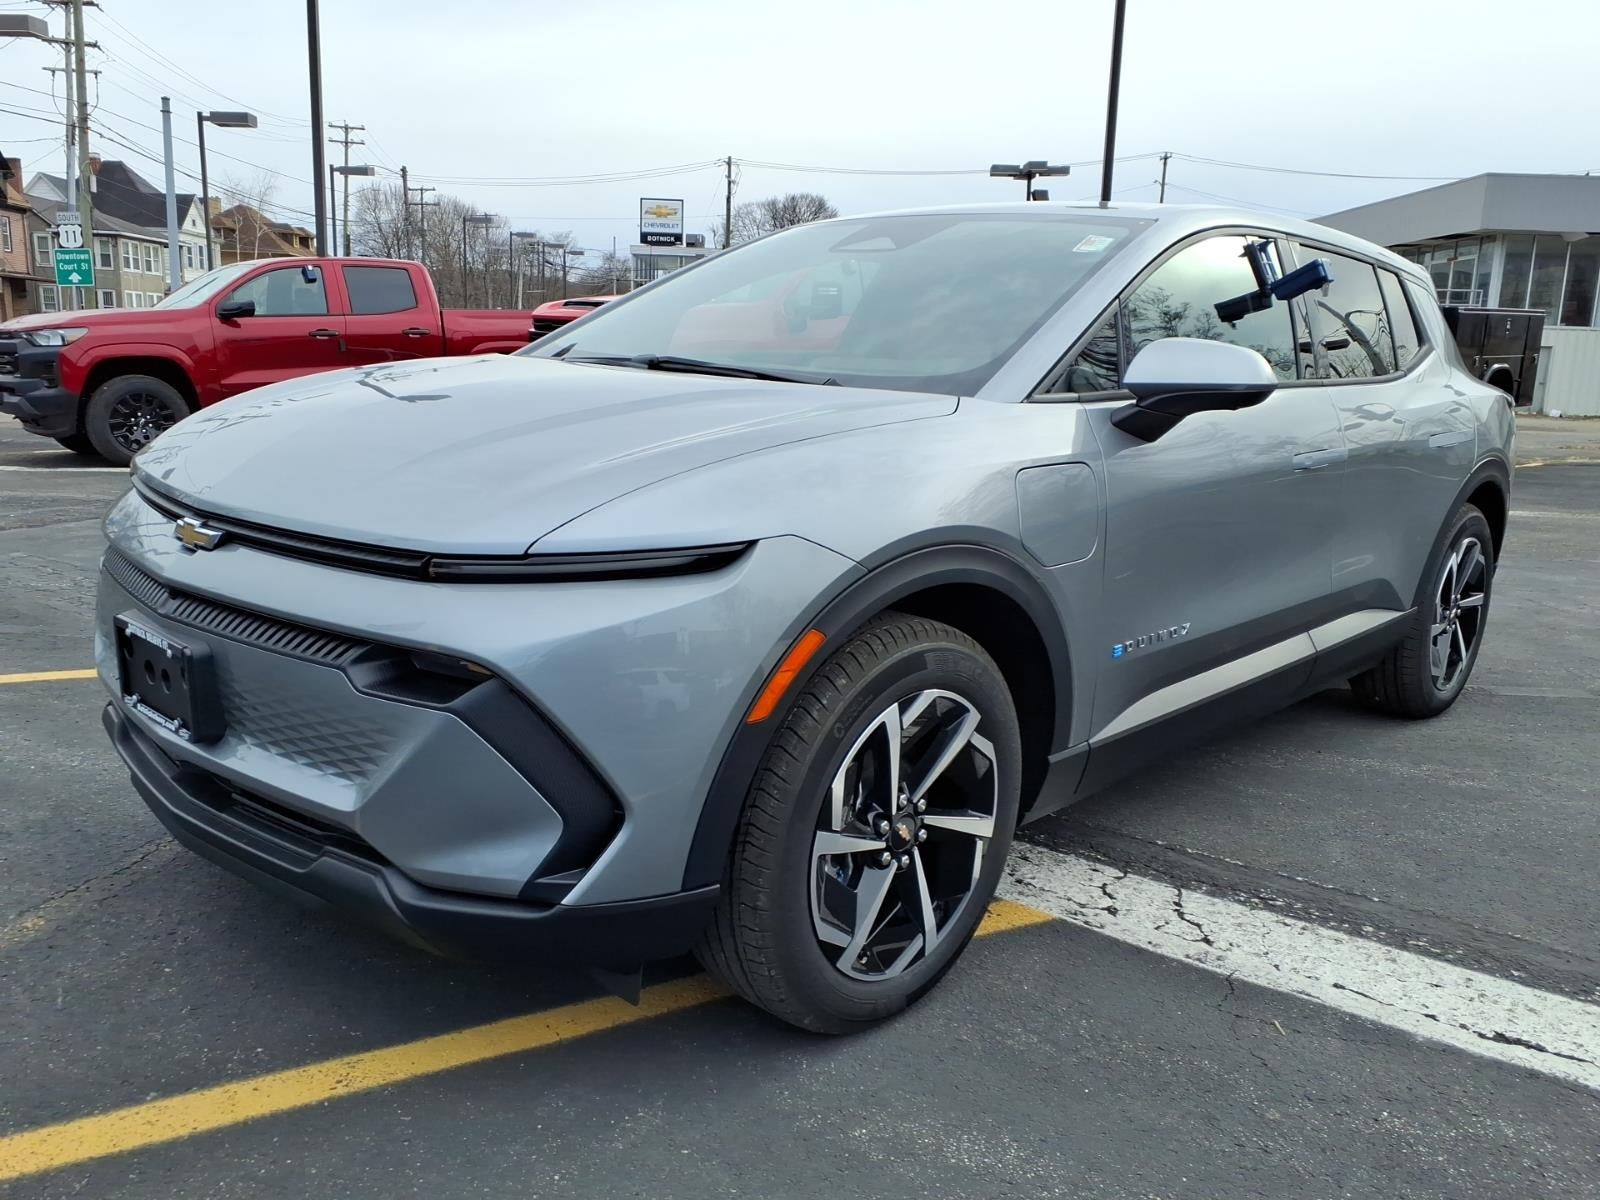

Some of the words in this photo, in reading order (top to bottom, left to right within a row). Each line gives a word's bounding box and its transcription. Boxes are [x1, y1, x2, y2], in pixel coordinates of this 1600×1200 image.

[65, 230, 77, 243] 11
[56, 252, 89, 260] Downtown
[59, 262, 78, 270] Court
[80, 262, 89, 270] St
[1112, 622, 1191, 658] EQUINOX
